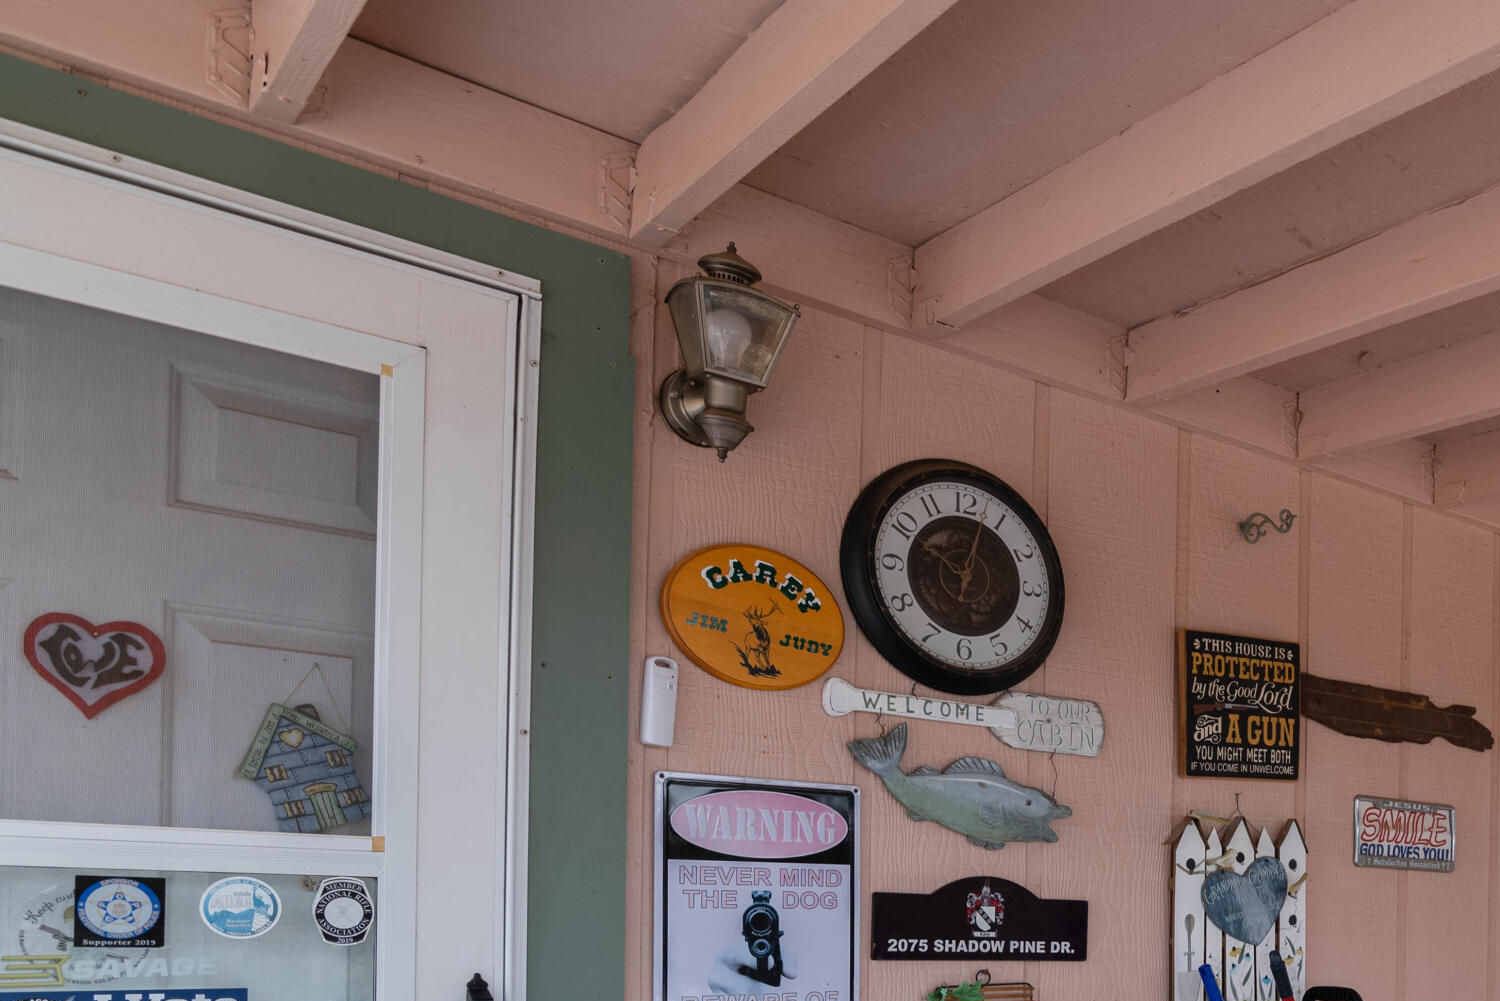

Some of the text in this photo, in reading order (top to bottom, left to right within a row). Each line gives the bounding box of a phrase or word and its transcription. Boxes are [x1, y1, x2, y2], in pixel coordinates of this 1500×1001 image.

[920, 493, 943, 518] 11
[954, 491, 977, 517] 12
[891, 511, 918, 541] 10
[992, 513, 1007, 531] 1
[881, 553, 905, 573] 9
[1012, 544, 1034, 563] 2
[701, 558, 821, 614] CAREY
[1022, 580, 1043, 599] 3
[890, 592, 914, 613] 8
[686, 611, 728, 633] JIM
[920, 622, 942, 645] 7
[1016, 614, 1034, 635] 4
[779, 633, 832, 657] JUDY
[956, 638, 973, 661] 6
[989, 634, 1008, 658] 5
[1202, 638, 1286, 661] THIS HOUSE IS
[1191, 652, 1295, 684] PROTECTED
[861, 691, 985, 722] WELCOME
[1192, 677, 1293, 714] by the Good Lord
[1025, 694, 1090, 723] TO OUR
[1017, 720, 1094, 752] CABIN
[1193, 713, 1296, 747] and A GUN
[1195, 745, 1291, 765] YOU MIGHT MEET BOTH
[1191, 761, 1294, 775] IF YOU COME IN UNWELCOME
[1384, 802, 1431, 812] JESUS
[684, 804, 836, 845] WARNING
[1360, 806, 1447, 848] SMILE
[1360, 842, 1450, 862] GOD LOVES YOU!
[326, 882, 363, 892] MEMBER
[679, 865, 842, 888] NEVER MIND
[317, 891, 372, 914] NATIONAL RIFLE
[682, 889, 839, 910] THE DOG
[319, 919, 369, 936] ASSOCIATION
[82, 939, 132, 947] Supporter
[887, 938, 1075, 954] 2075 SHADOW PINE DR.
[73, 957, 217, 979] SAVAGE
